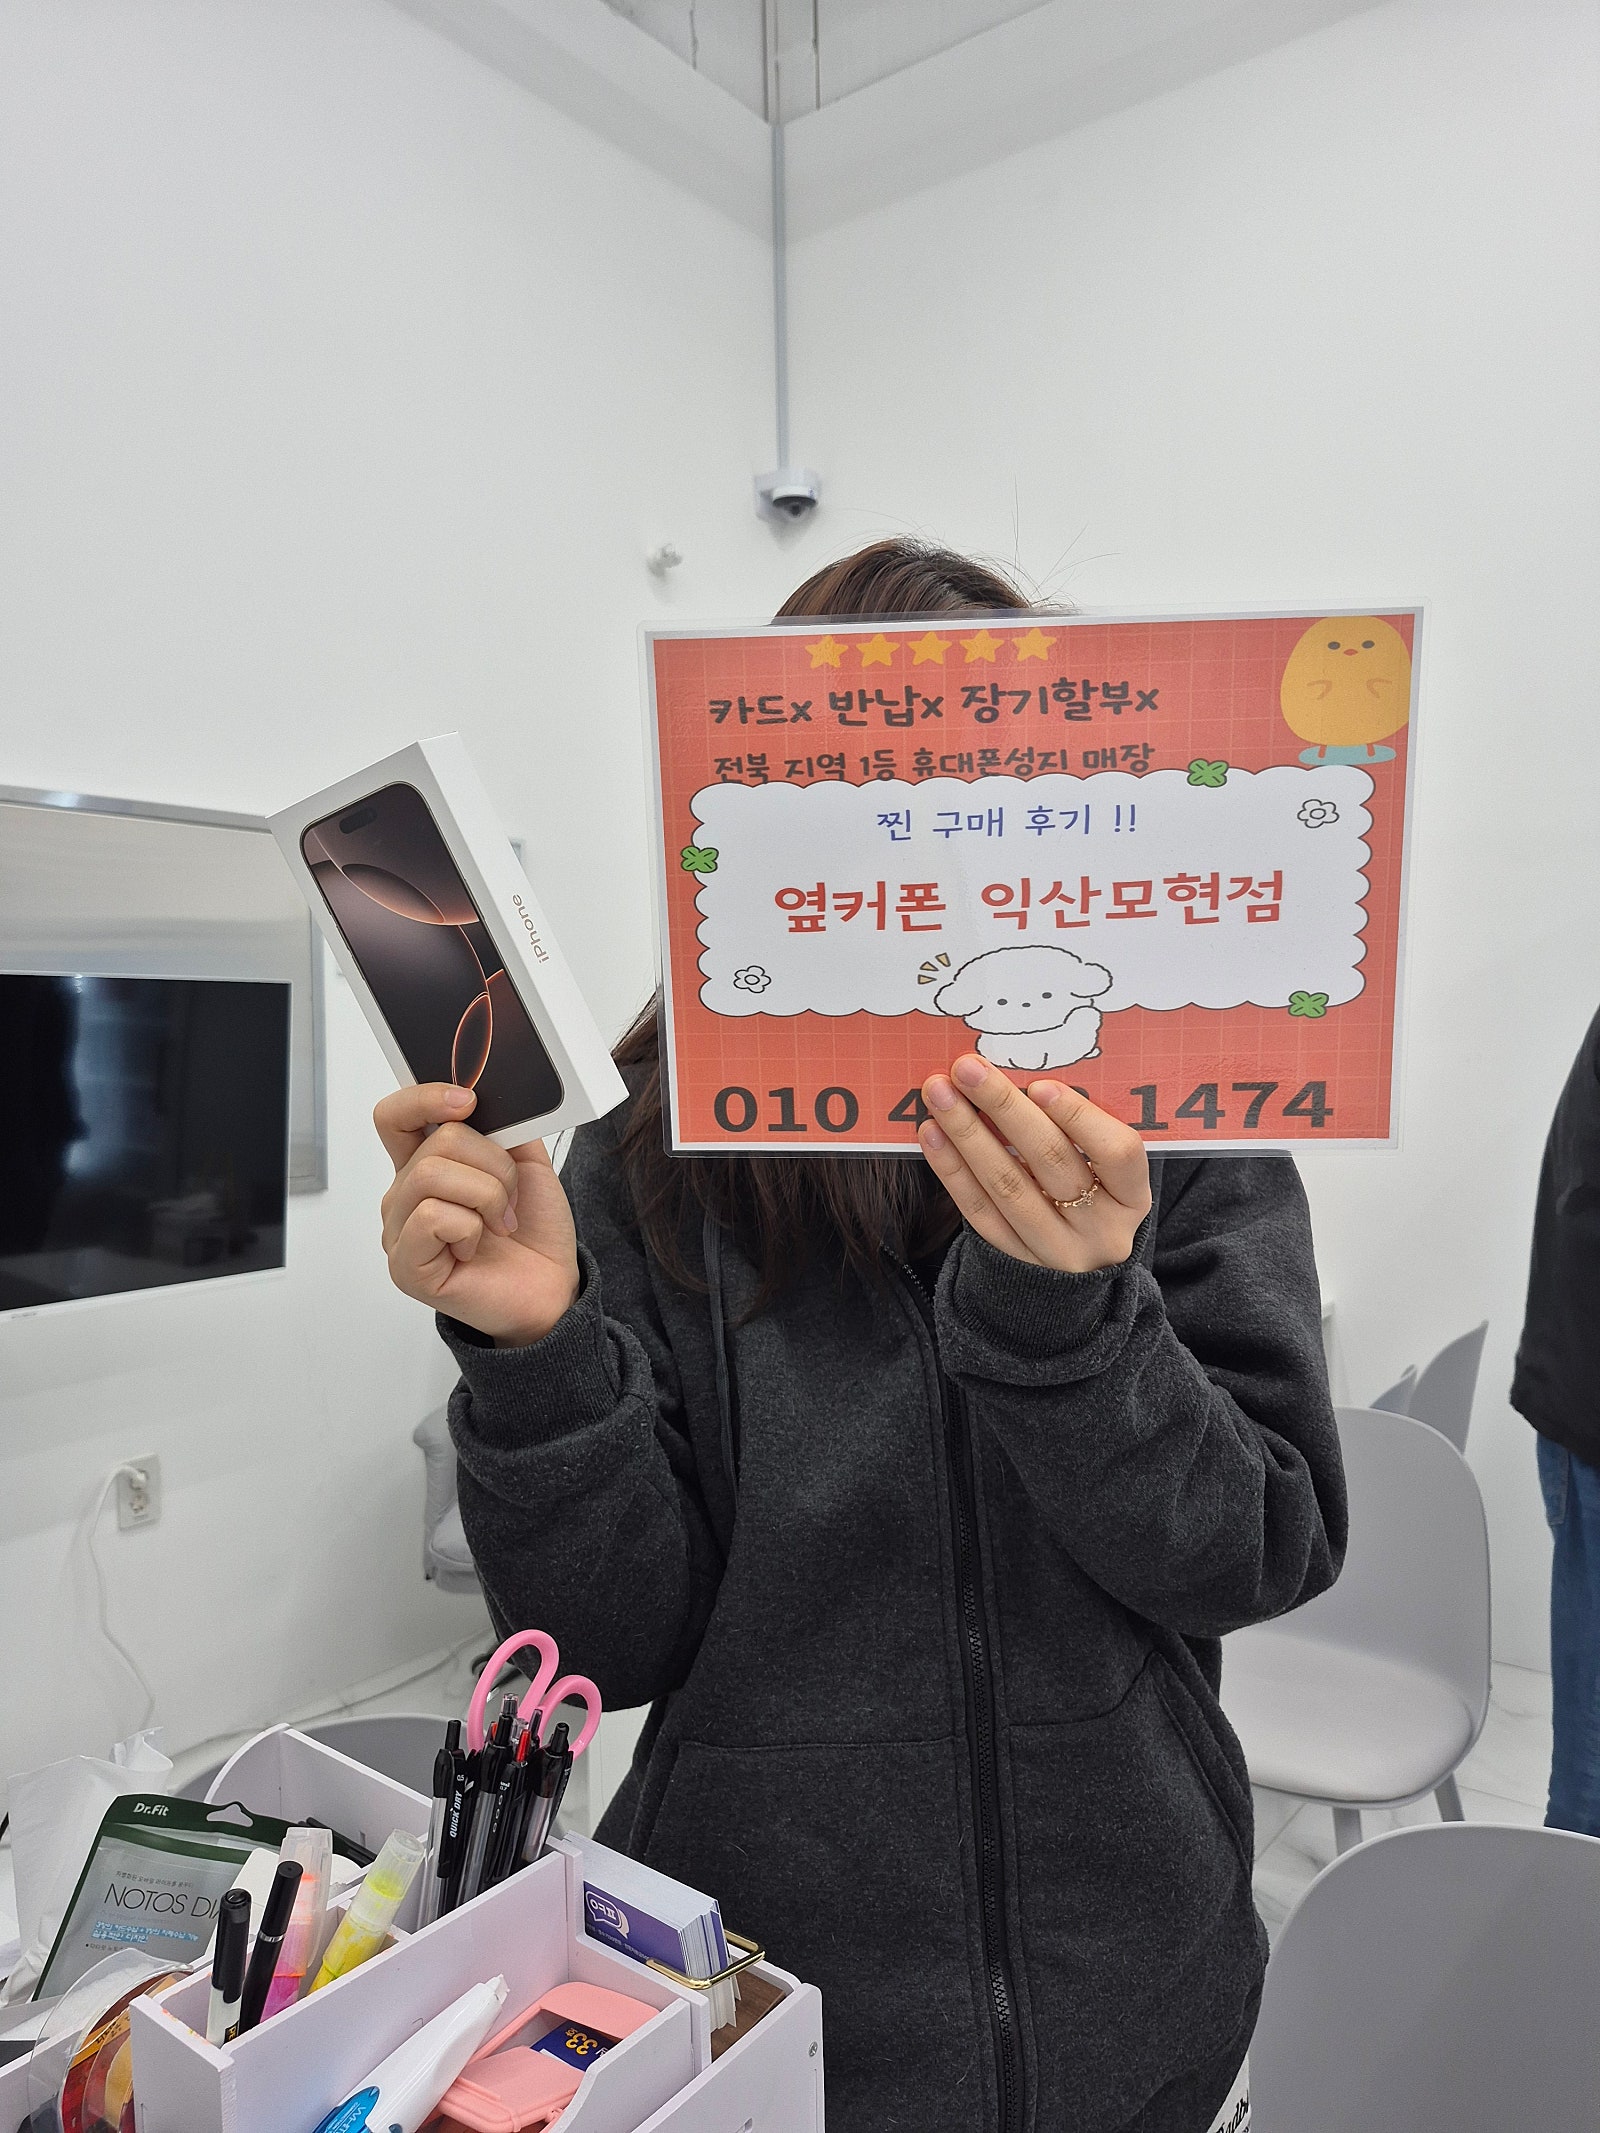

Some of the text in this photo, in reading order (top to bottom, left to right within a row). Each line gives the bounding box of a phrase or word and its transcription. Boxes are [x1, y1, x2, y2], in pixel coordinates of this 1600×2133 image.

[709, 677, 1159, 727] 카드x 반납x 장기할부x
[714, 742, 1156, 784] 전북 지역 1등 휴대폰성지 매장
[876, 803, 1137, 841] 찐 구매 후기 !!
[774, 870, 1284, 933] 옆커폰 익산모현점
[512, 894, 550, 963] iPhone
[713, 1086, 859, 1132] 010
[1128, 1081, 1334, 1131] 1474
[133, 1802, 170, 1817] Dr.Fit
[450, 1790, 463, 1838] QUICK DRY
[104, 1883, 188, 1915] NOTOS
